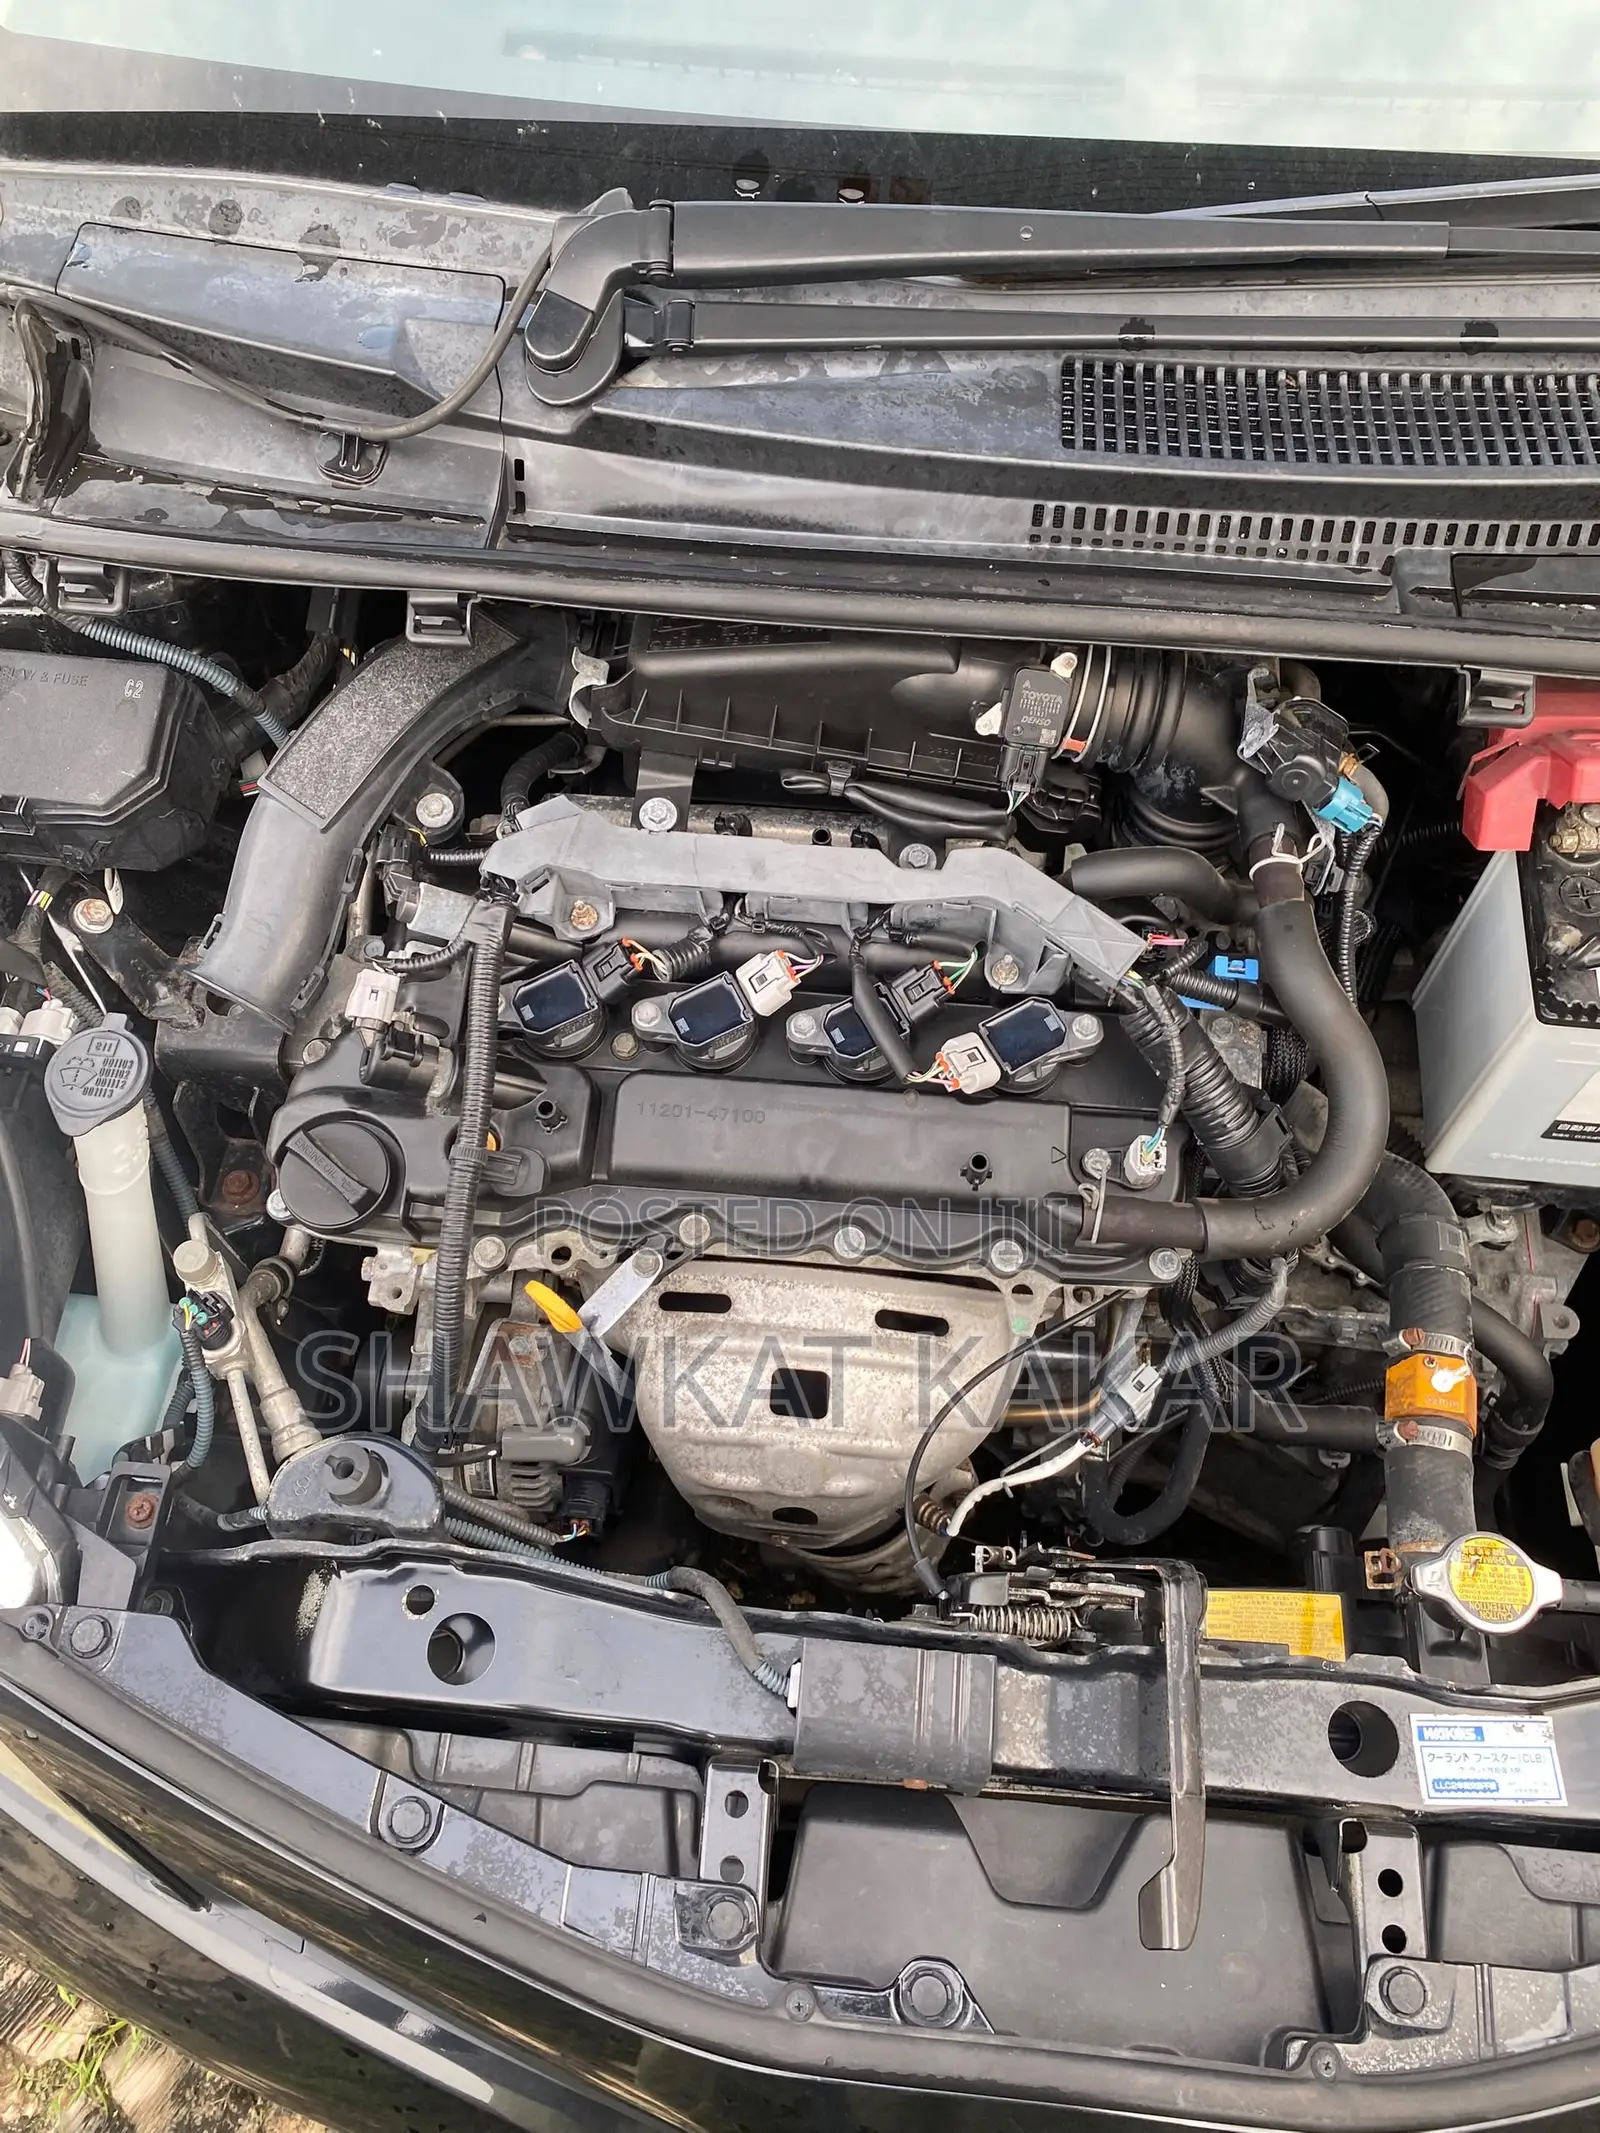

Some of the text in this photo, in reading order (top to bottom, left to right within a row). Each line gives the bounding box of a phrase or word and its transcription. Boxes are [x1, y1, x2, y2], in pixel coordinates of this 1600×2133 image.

[53, 672, 90, 687] FUSE
[124, 678, 144, 699] C2
[1022, 690, 1063, 704] TOYOTA
[1021, 715, 1052, 726] DENSO
[637, 1101, 766, 1124] 11201-47100
[294, 1138, 338, 1180] ENGINE OIL
[1469, 1601, 1512, 1612] ATTENTION
[1479, 1610, 1513, 1621] CAUTION
